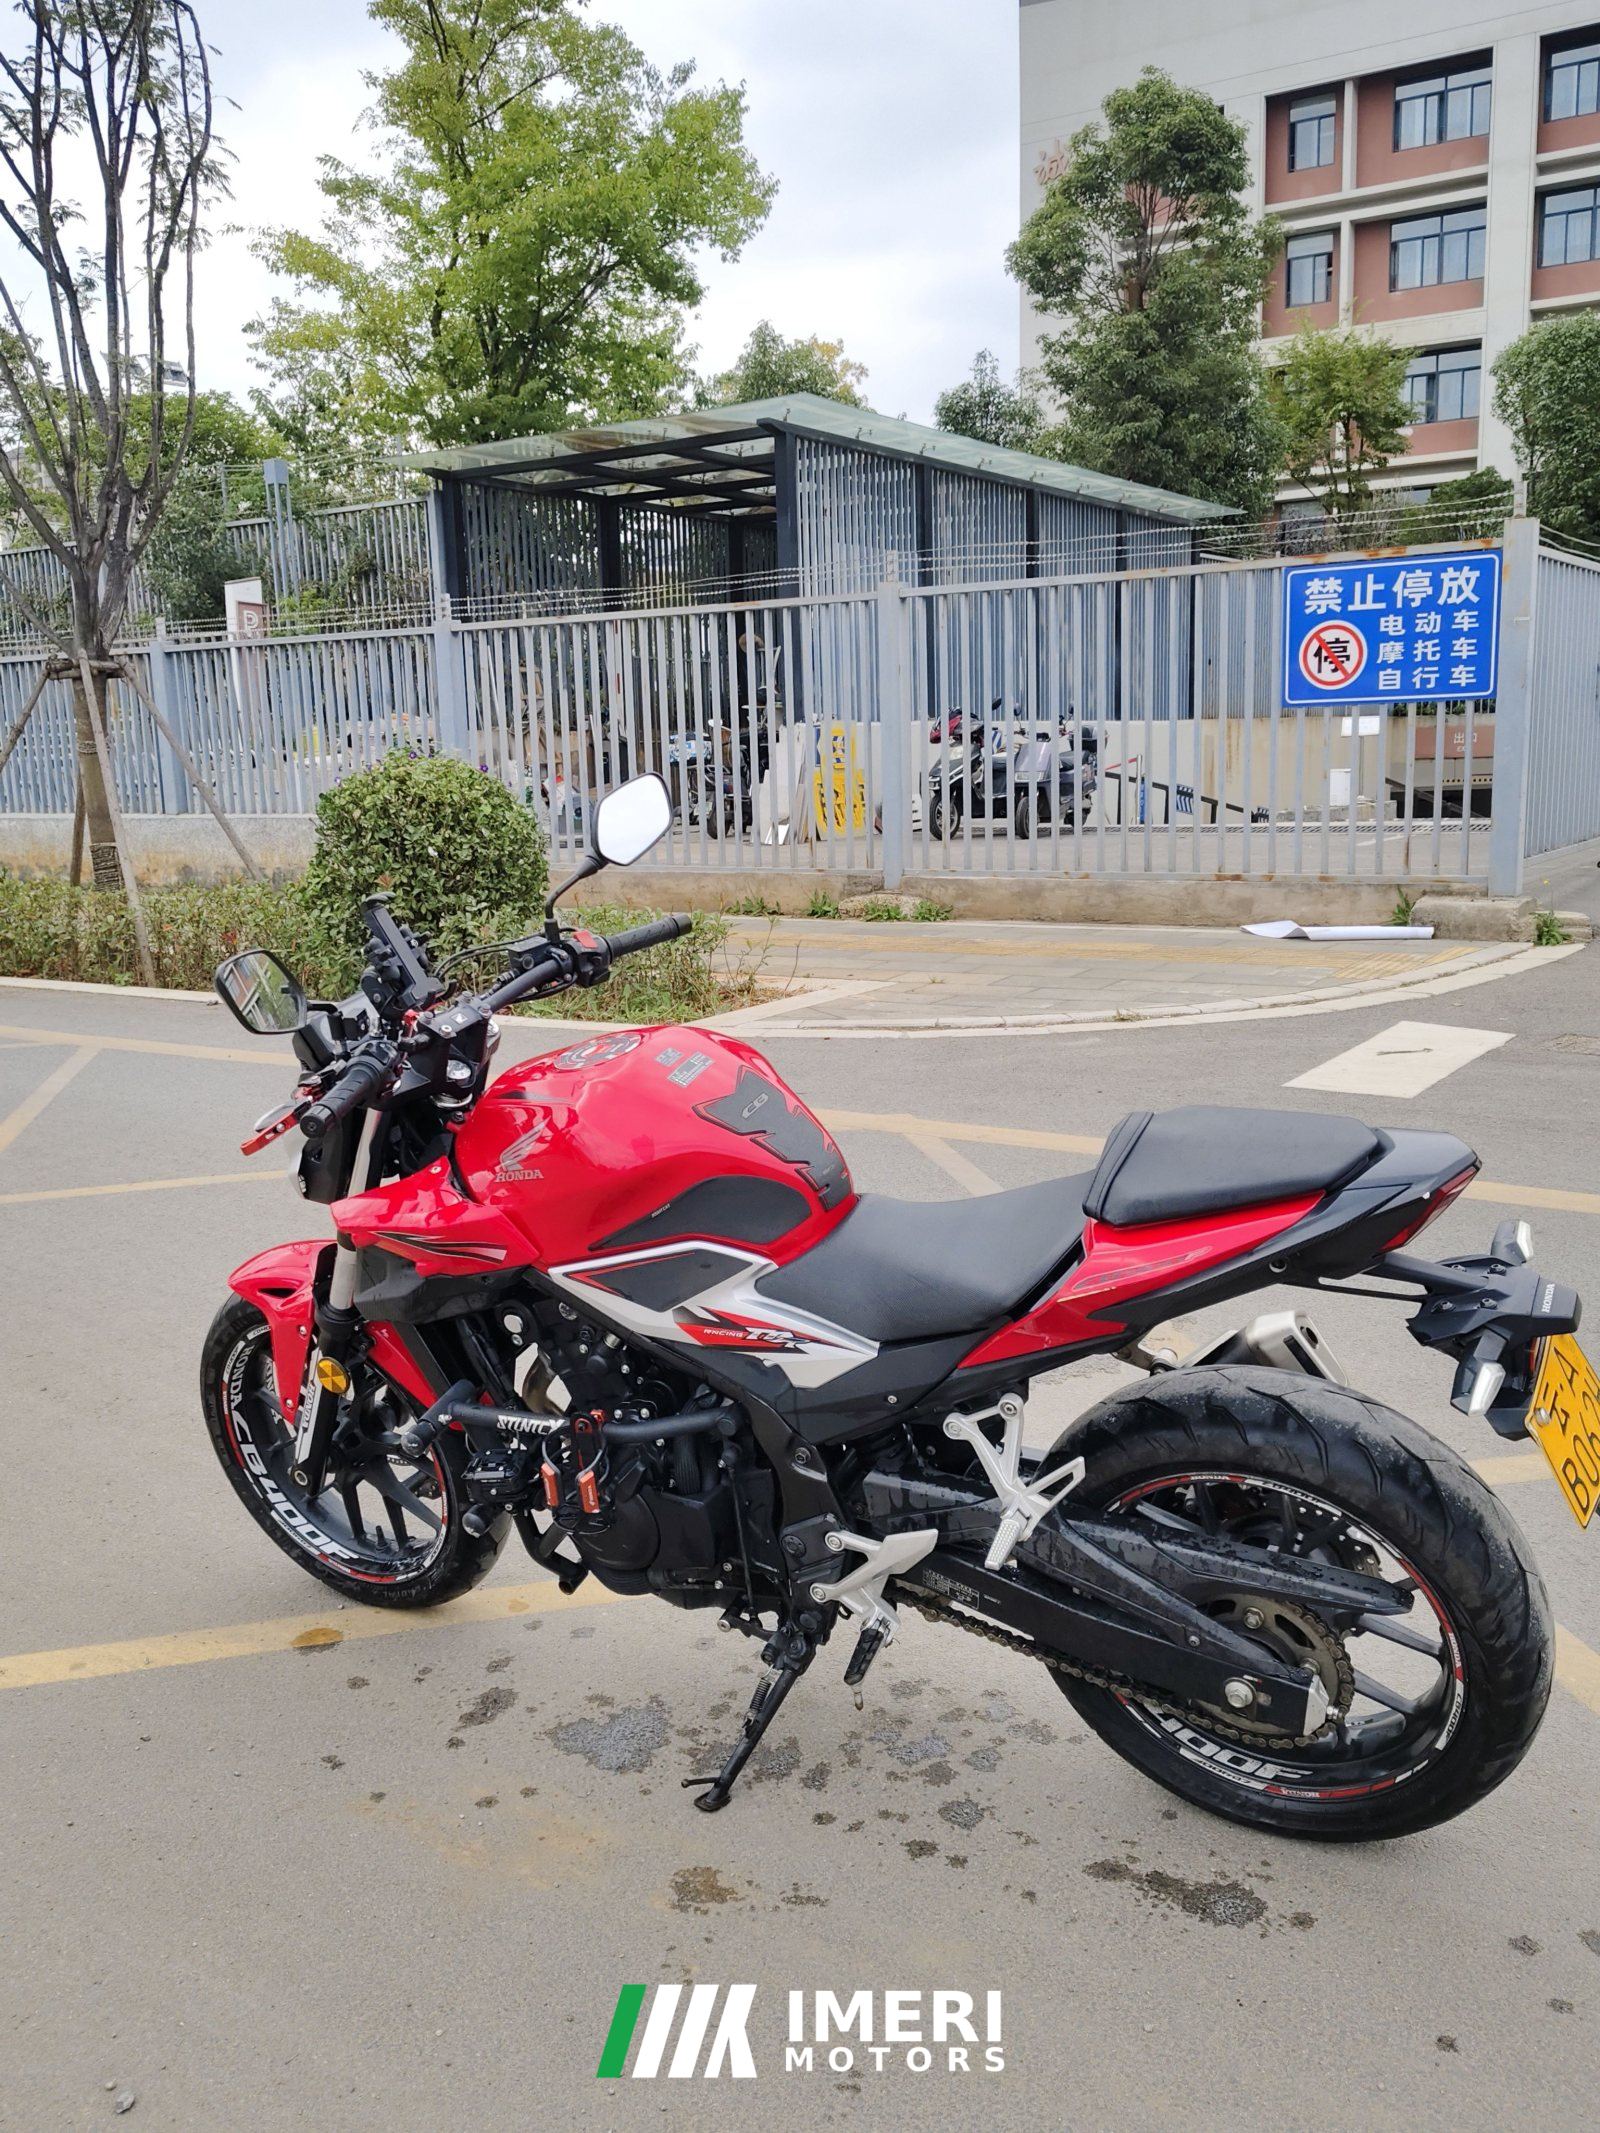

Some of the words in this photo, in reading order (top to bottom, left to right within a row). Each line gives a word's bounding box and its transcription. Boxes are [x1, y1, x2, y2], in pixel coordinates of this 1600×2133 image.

[1304, 565, 1480, 615] 禁止停放
[1379, 609, 1479, 636] 电动车
[1376, 636, 1478, 664] 摩托车
[1378, 664, 1477, 691] 自行车
[494, 1169, 544, 1182] HONDA
[1541, 1283, 1556, 1314] HONDA
[231, 1344, 255, 1409] HONDA
[302, 1383, 316, 1429] HONDA
[231, 1409, 359, 1559] CB400F
